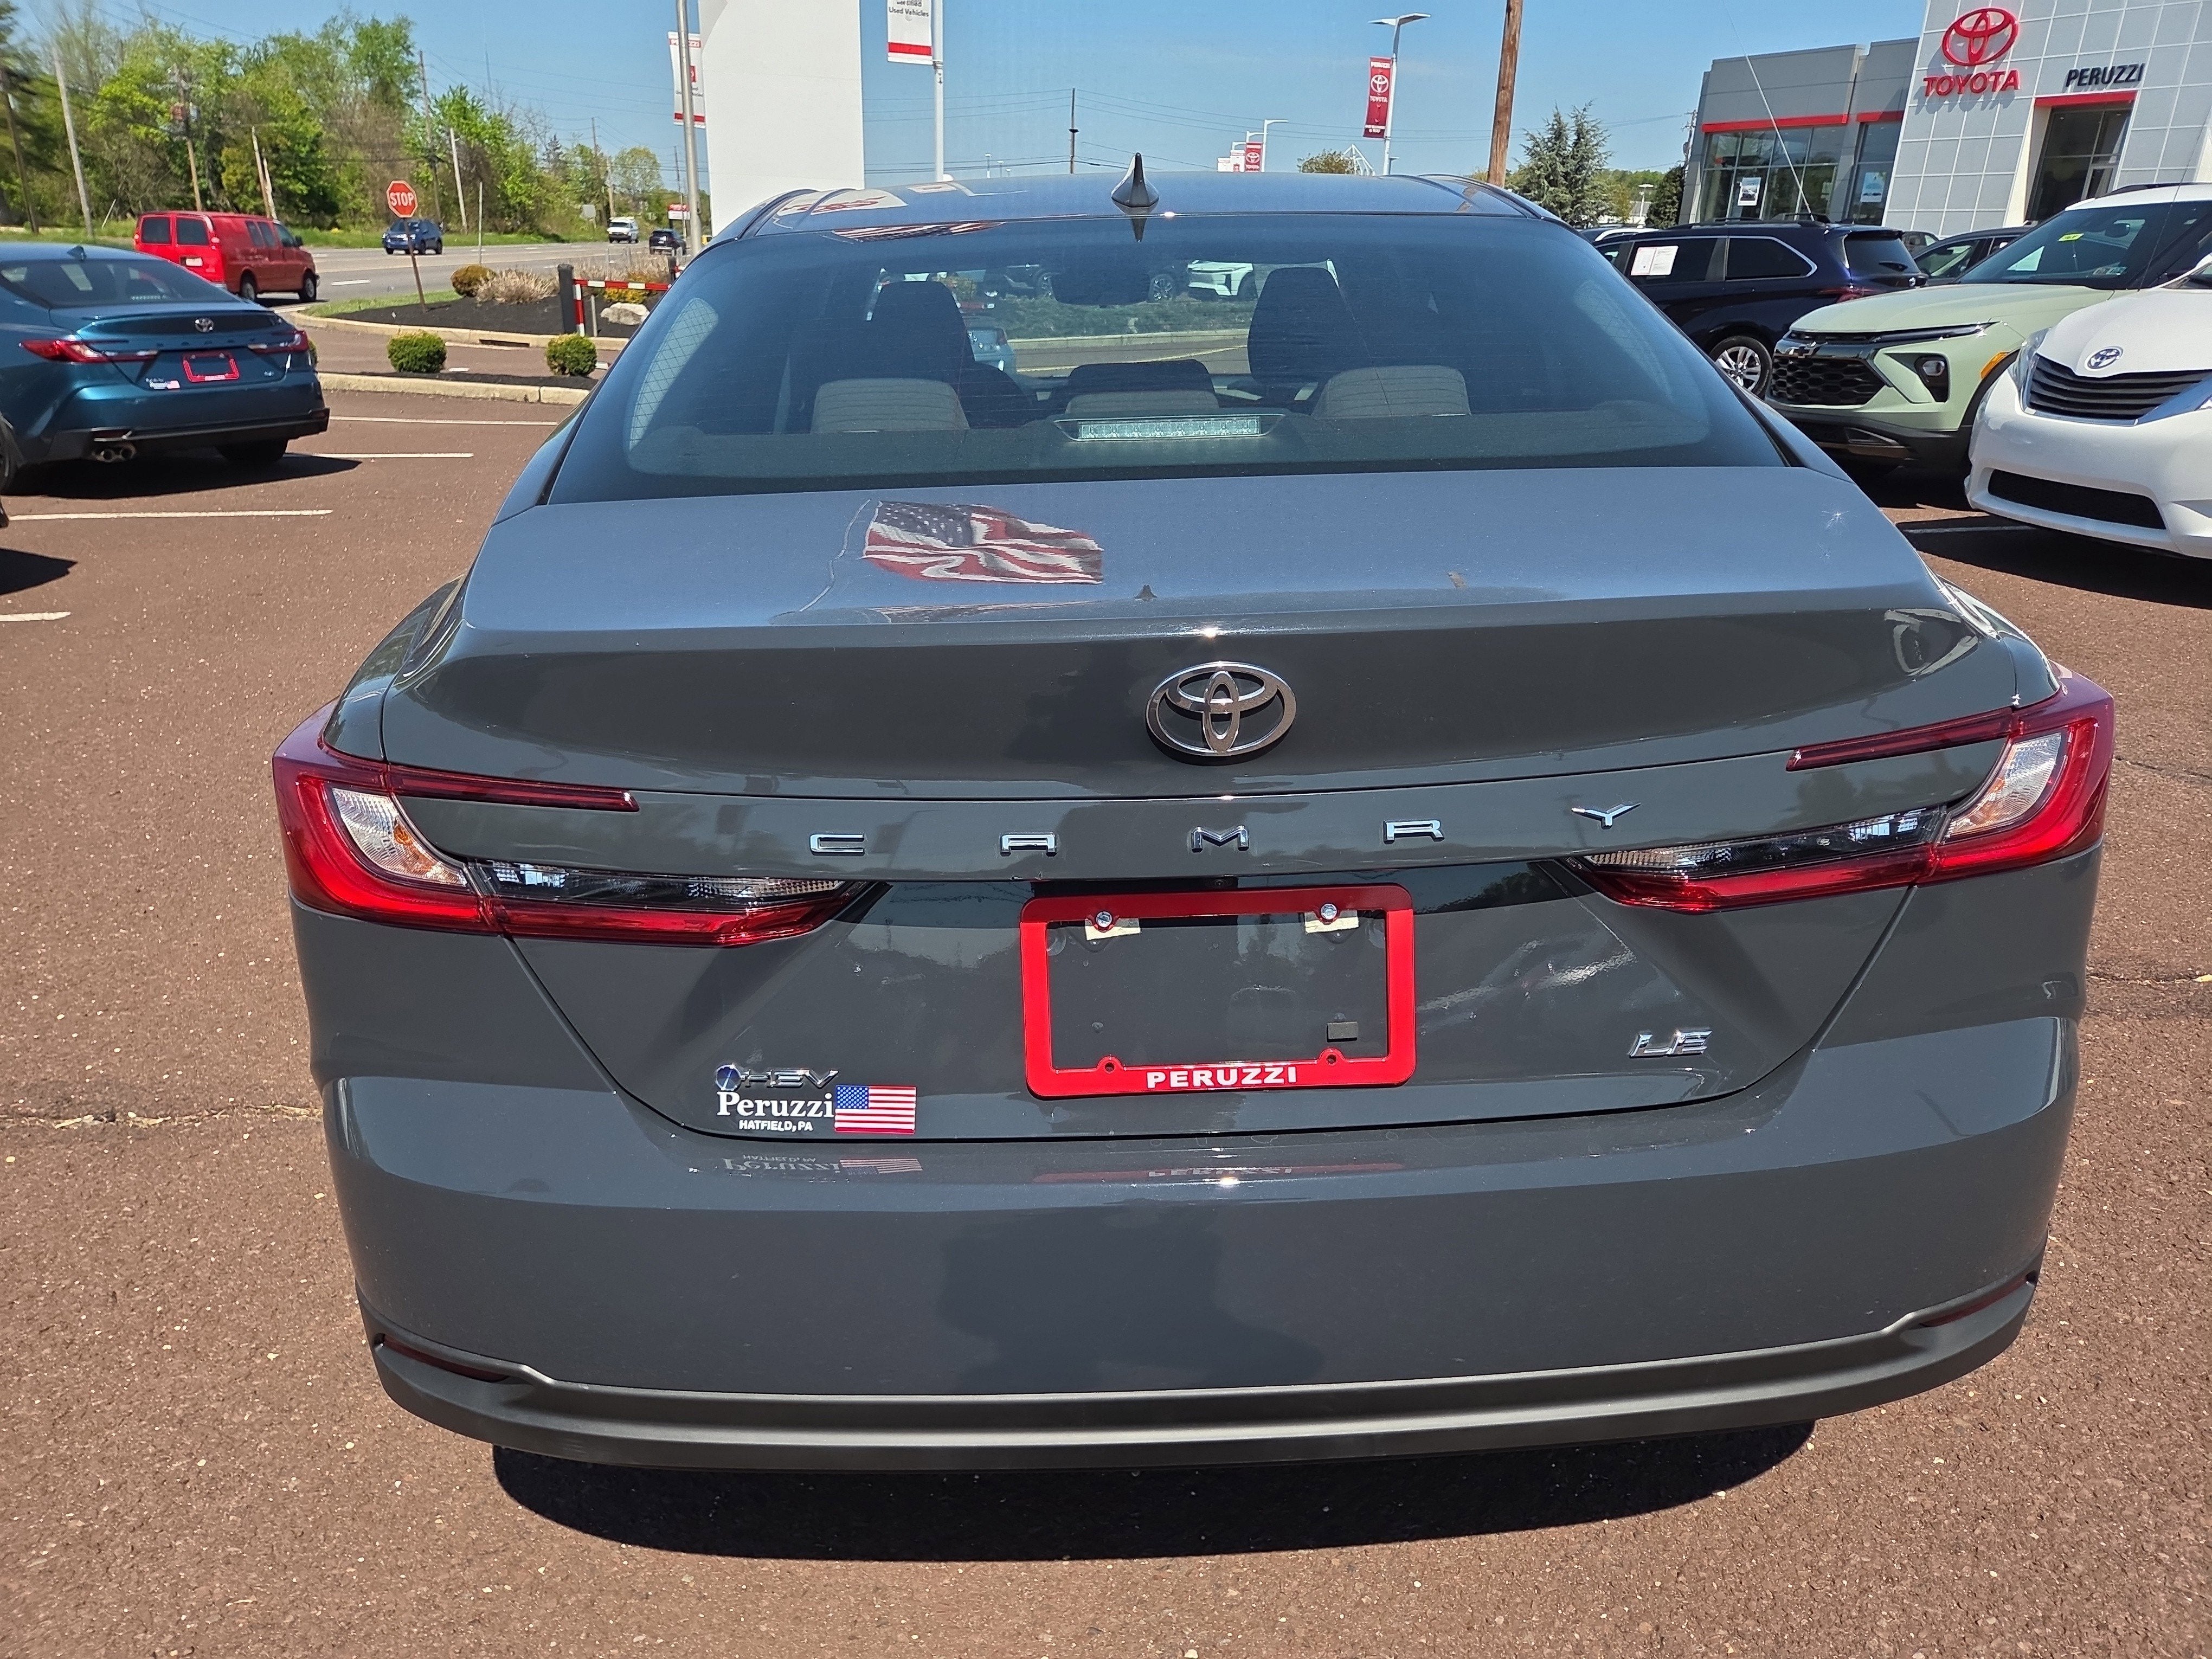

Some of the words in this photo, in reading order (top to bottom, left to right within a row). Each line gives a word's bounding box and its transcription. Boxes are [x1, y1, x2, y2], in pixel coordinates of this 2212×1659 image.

[904, 8, 929, 17] Vehicles
[1923, 69, 2020, 97] TOYOTA
[2066, 63, 2146, 87] PERUZZI
[390, 192, 414, 206] STOP
[809, 801, 1641, 857] CAMRY
[1629, 1030, 1713, 1059] LE
[741, 1068, 839, 1089] HEV
[1147, 1066, 1296, 1089] PERUZZI
[716, 1091, 834, 1118] Peruzzi
[739, 1120, 797, 1132] HATFIELD,
[798, 1121, 813, 1131] PA
